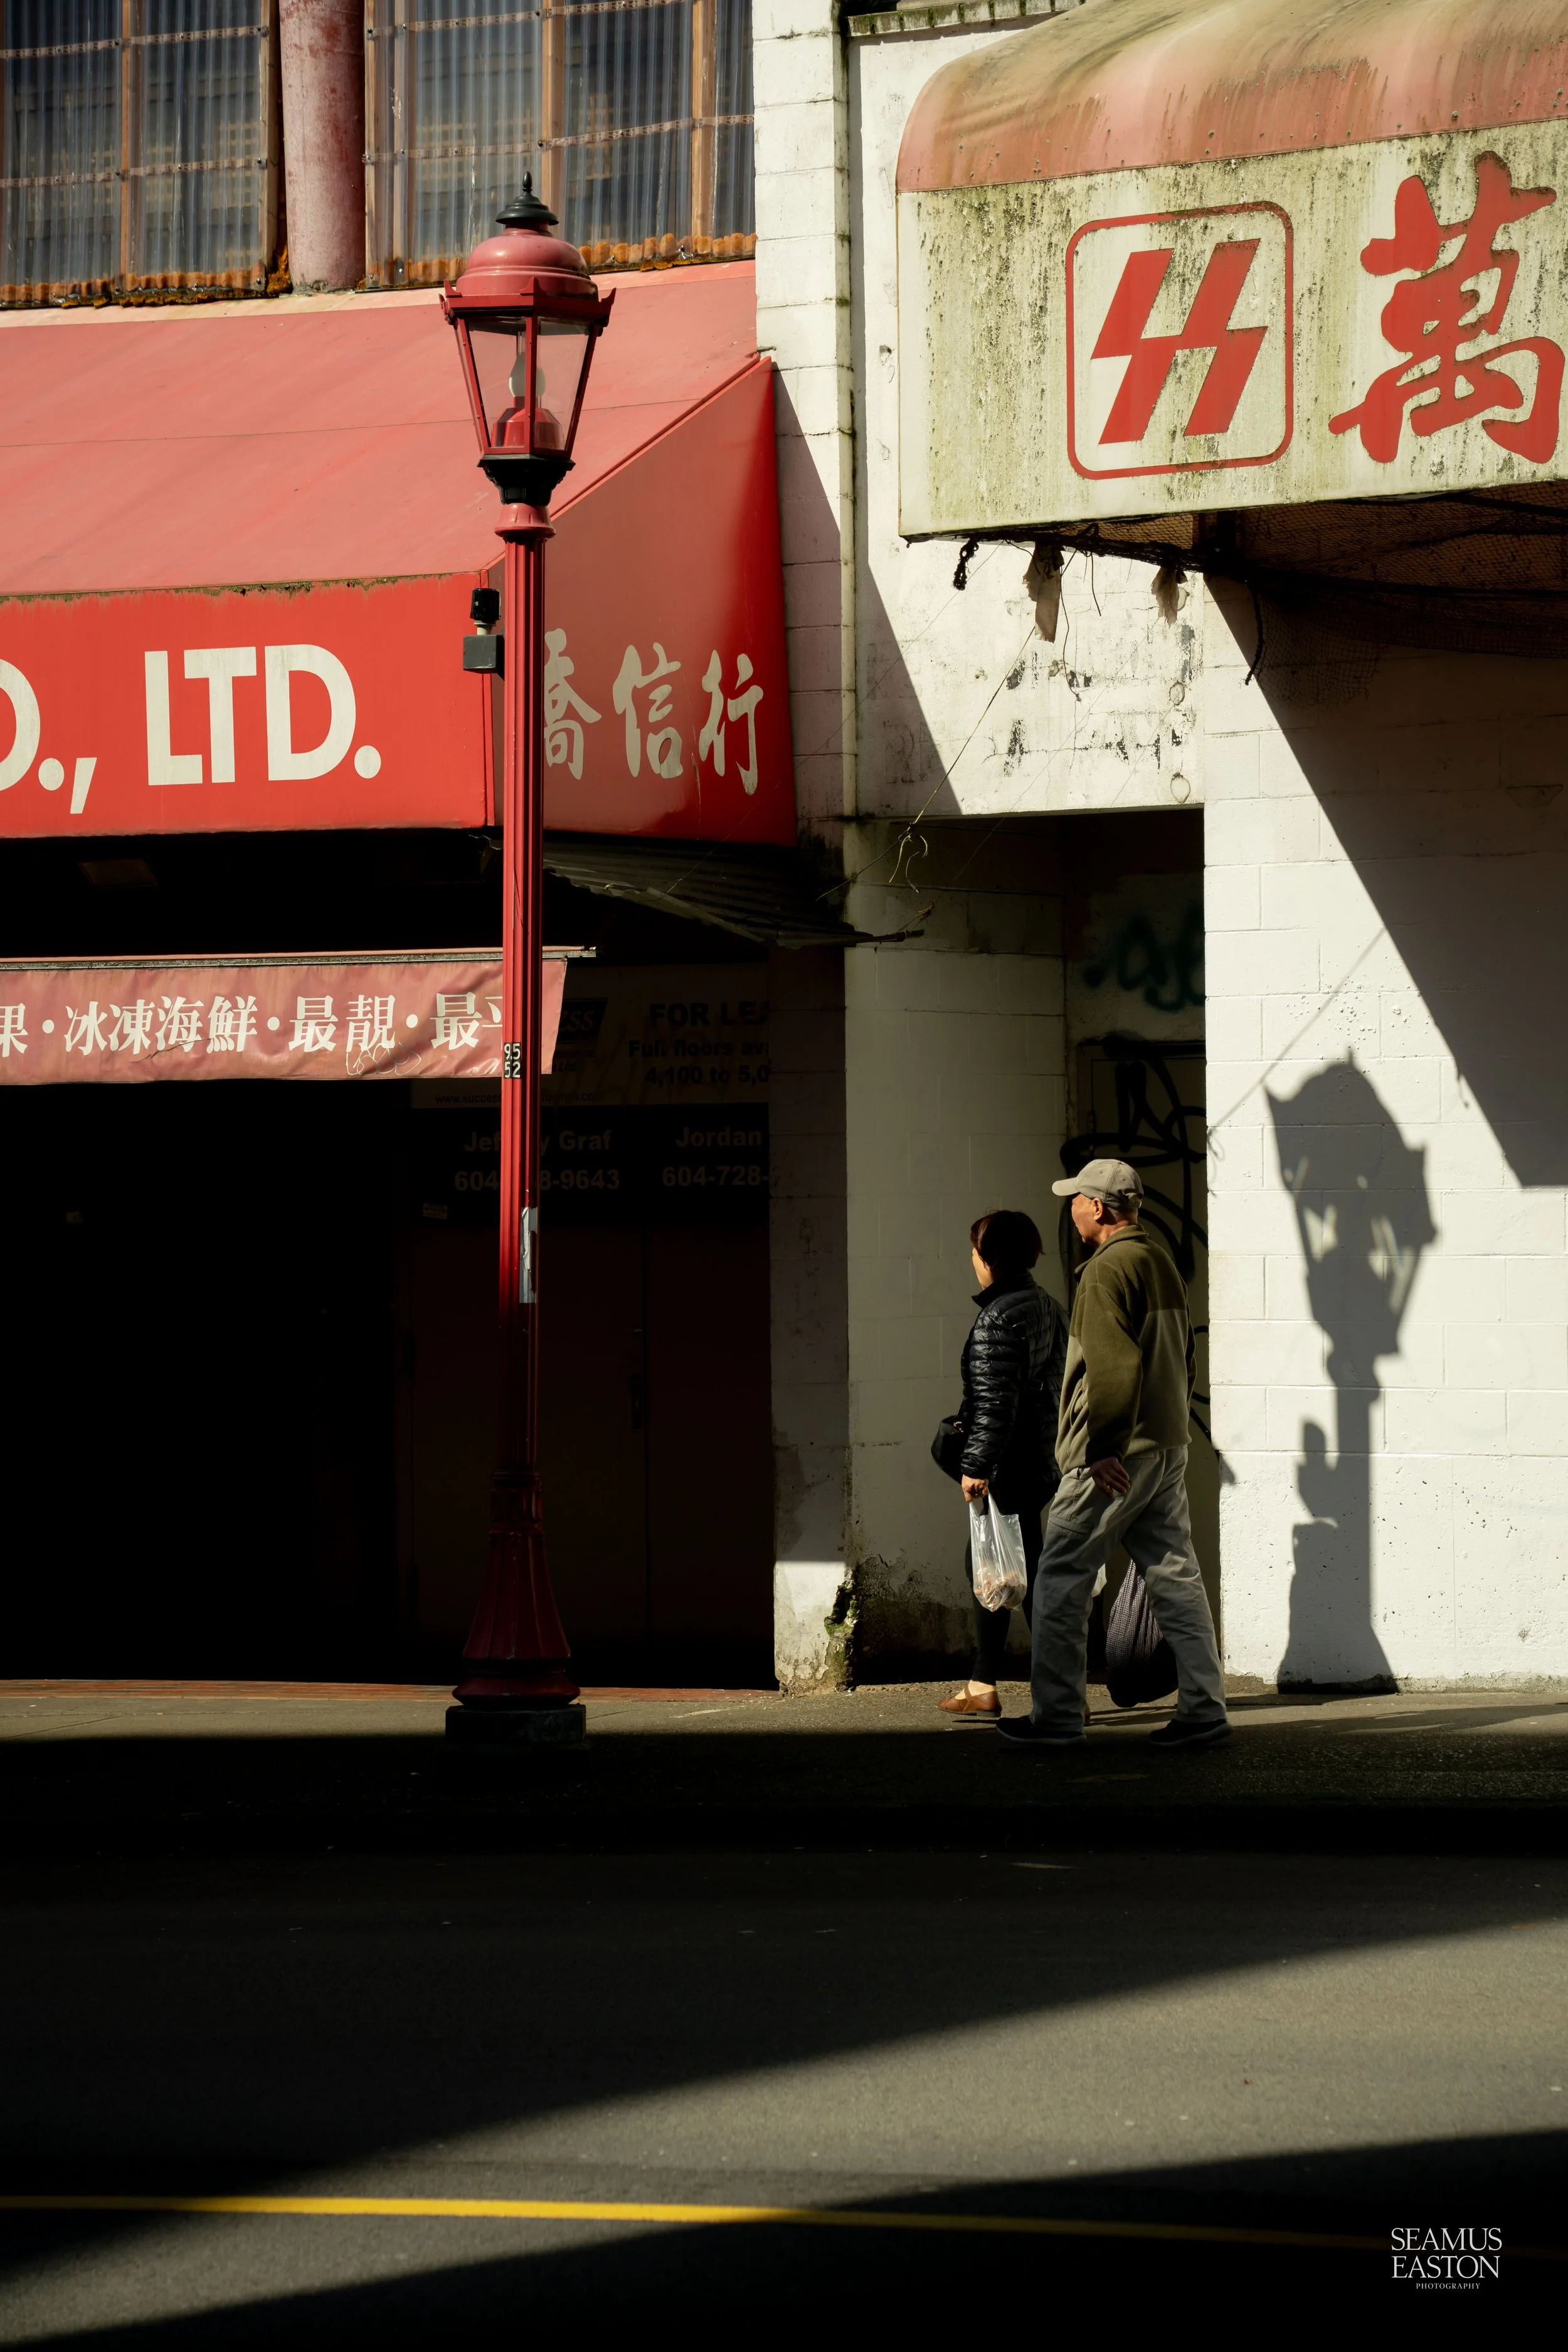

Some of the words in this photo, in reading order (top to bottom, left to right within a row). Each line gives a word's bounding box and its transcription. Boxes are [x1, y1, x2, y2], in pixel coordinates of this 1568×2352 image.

[1328, 151, 1565, 464] 萬
[144, 644, 381, 785] LTD.
[650, 1002, 709, 1027] FOR
[674, 1039, 733, 1057] floors
[741, 1042, 769, 1056] av
[645, 1066, 702, 1088] 4,100
[710, 1066, 730, 1083] to
[559, 1129, 612, 1152] Graf
[675, 1126, 762, 1148] Jordan
